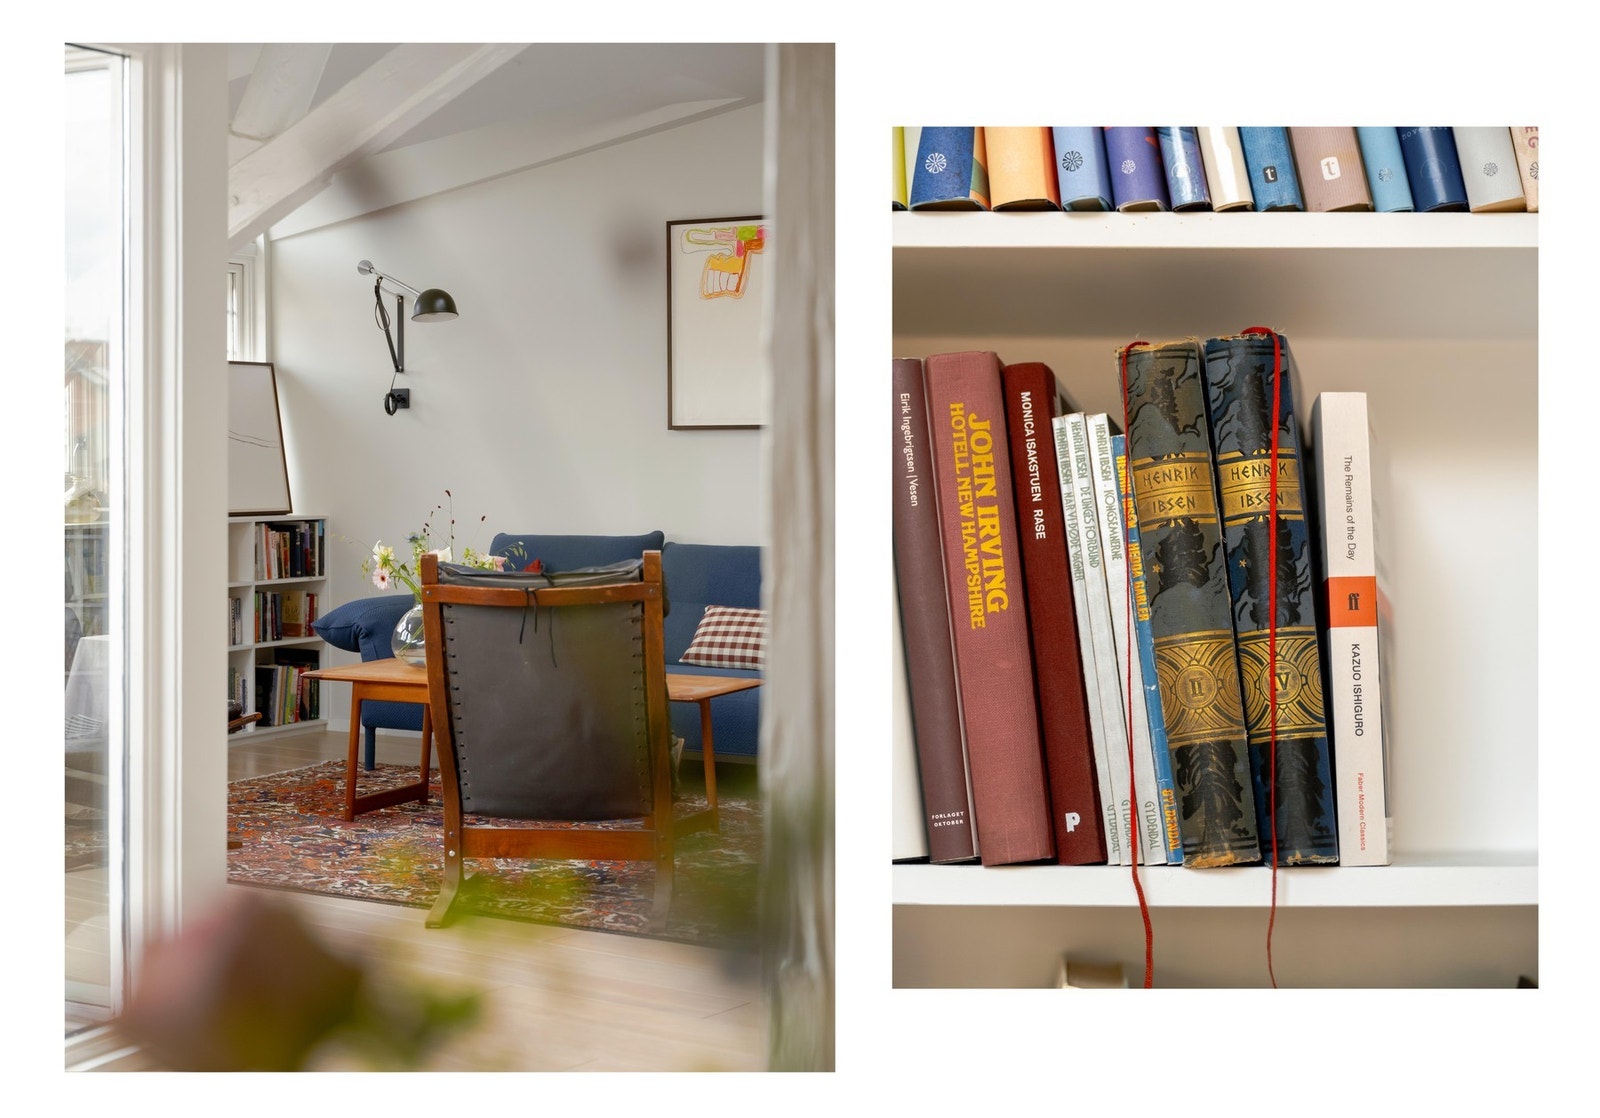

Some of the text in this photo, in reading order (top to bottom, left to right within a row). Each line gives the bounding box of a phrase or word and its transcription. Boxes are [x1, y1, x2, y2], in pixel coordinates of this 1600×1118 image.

[900, 392, 910, 414] Eirik
[900, 416, 915, 473] Ingebrigtsen
[1055, 427, 1068, 459] HENRIK
[1020, 391, 1046, 540] MONICA ISAKSTUEN RASE
[1059, 459, 1073, 485] IBSEN
[1143, 465, 1199, 487] HENRIK
[1231, 461, 1288, 481] HENRK
[907, 479, 918, 507] Vesen
[968, 412, 1009, 614] JOHN IRVING
[1071, 420, 1100, 568] HENRIK IBSEN DE UNGES FORBUND
[1095, 423, 1123, 561] HENRIK IBSEN KONGSEMNERNE
[1152, 495, 1196, 514] IBSEN
[1344, 455, 1357, 561] The Remains of the Day
[950, 402, 986, 630] HOTELL NEW HAMPSHIRE
[1128, 543, 1144, 578] HEDDA
[1133, 579, 1150, 621] GABLER
[1351, 643, 1364, 737] KAZUO ISHIGURO
[931, 811, 965, 820] FORLAGET
[934, 819, 964, 827] OKTOBER
[1144, 801, 1161, 850] GYLDENDAL
[1161, 788, 1181, 852] GYLDENDAL
